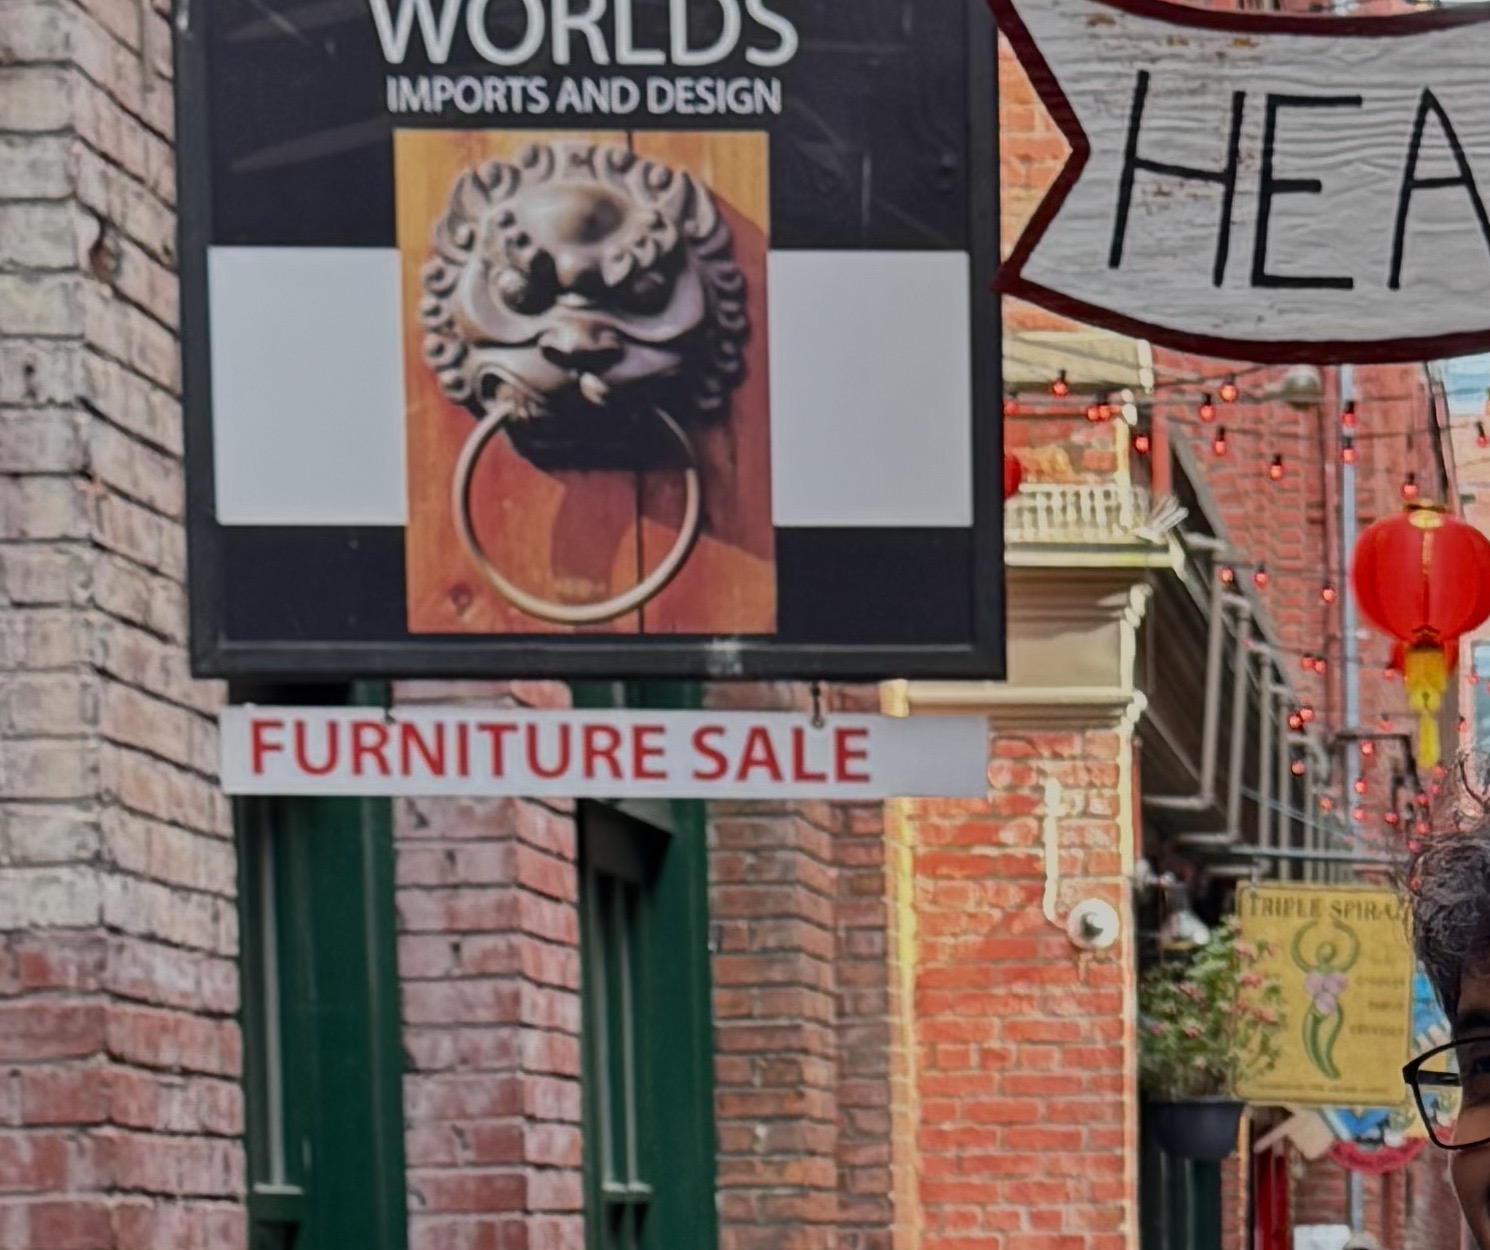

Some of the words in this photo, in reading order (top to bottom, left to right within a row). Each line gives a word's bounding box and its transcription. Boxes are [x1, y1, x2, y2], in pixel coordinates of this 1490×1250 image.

[369, 0, 799, 66] WORLDS
[386, 75, 549, 115] IMPORTS
[555, 76, 640, 115] AND
[646, 77, 782, 115] DESIGN
[250, 719, 667, 781] FURNITURE
[691, 726, 871, 784] SALE
[1250, 892, 1322, 918] TRIPLE
